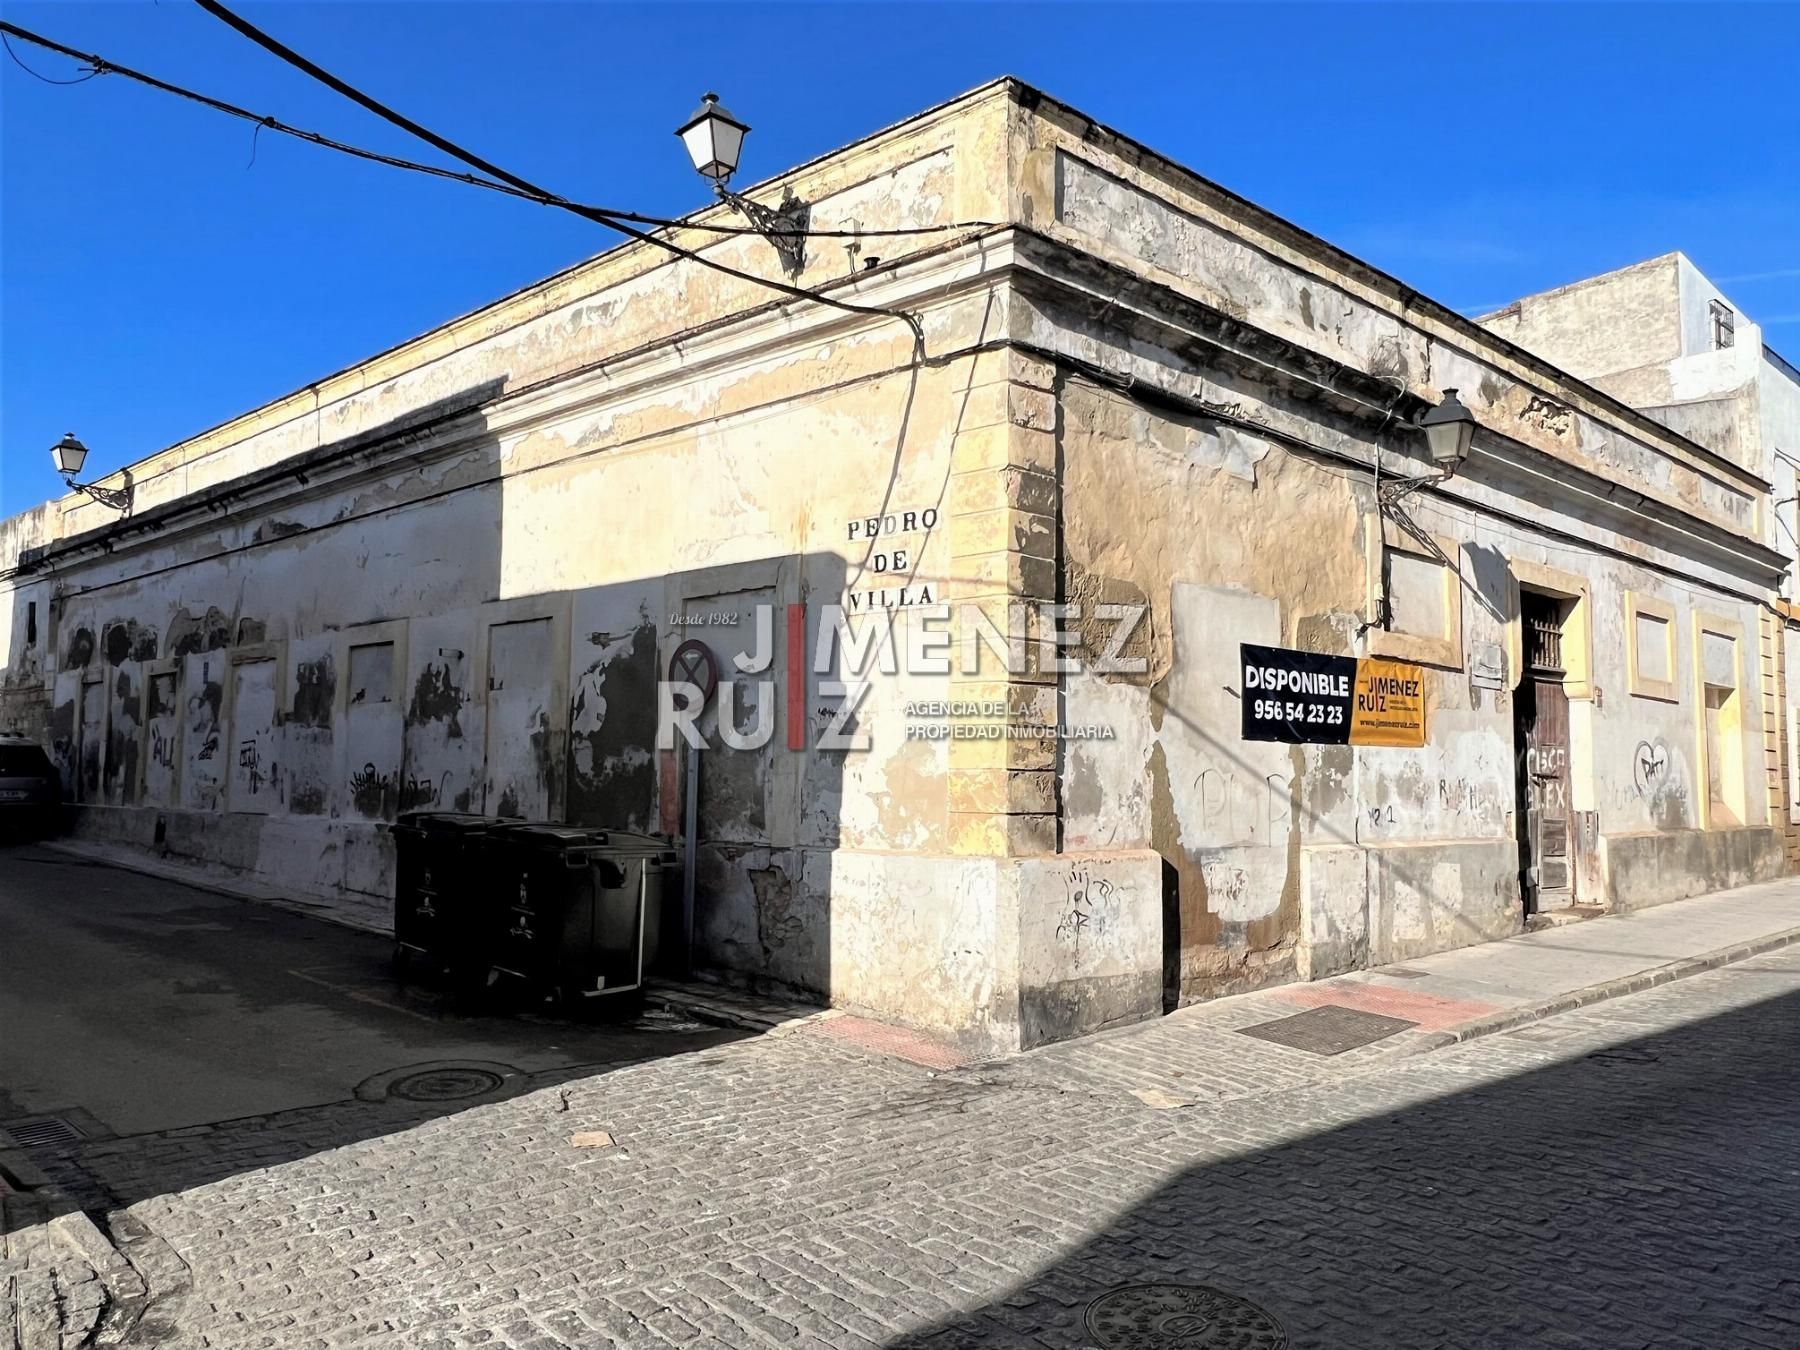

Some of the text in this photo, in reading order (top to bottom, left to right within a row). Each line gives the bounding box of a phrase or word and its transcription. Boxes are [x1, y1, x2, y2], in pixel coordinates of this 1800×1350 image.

[848, 508, 937, 540] PEDRO
[874, 550, 907, 573] DE
[850, 585, 932, 611] VILLA
[1245, 665, 1349, 697] DISPONIBLE
[1368, 676, 1419, 697] JIMENEZ
[1254, 699, 1343, 724] 956 54 23 23
[1358, 694, 1386, 712] RUIZ
